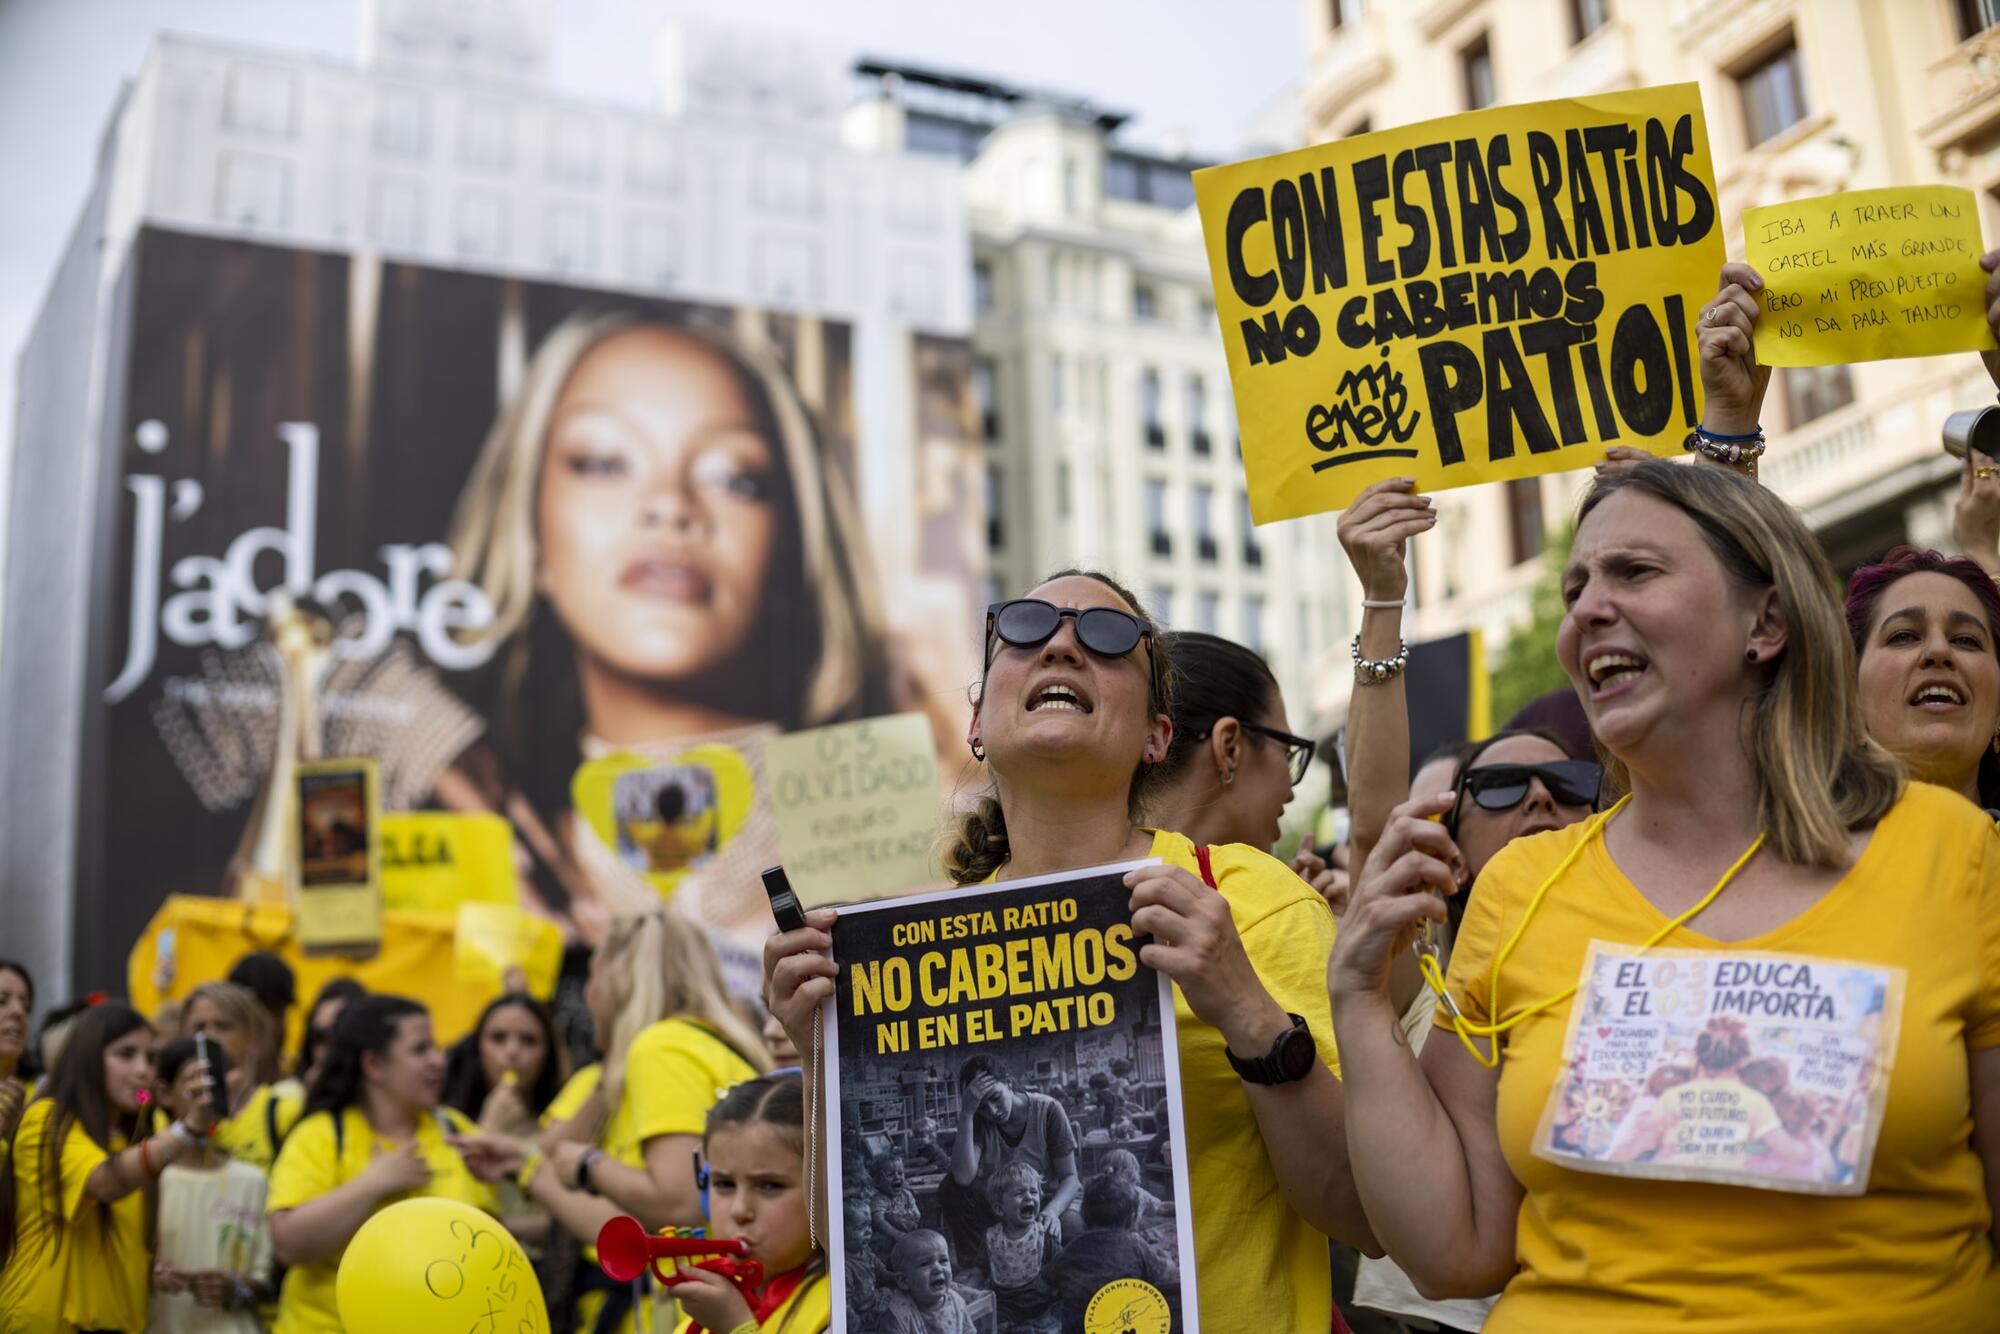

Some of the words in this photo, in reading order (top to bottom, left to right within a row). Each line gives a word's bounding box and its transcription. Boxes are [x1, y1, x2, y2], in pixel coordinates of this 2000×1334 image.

[1226, 167, 1348, 307] CON
[1352, 134, 1530, 285] ESTAS
[1761, 219, 1806, 244] IBA
[1829, 211, 1841, 229] A
[1853, 203, 1919, 225] TRAER
[1930, 203, 1961, 219] UN
[1768, 250, 1837, 273] CARTEL
[1760, 288, 1803, 313] PERO
[1849, 272, 1957, 301] PRESUPUESTO
[1240, 303, 1320, 366] NO
[1780, 322, 1803, 339] NO
[1814, 317, 1841, 333] DA
[1852, 308, 1891, 330] PARA
[1901, 304, 1961, 325] TANTO
[892, 919, 936, 947] CON
[940, 911, 998, 940] ESTA
[1003, 898, 1078, 931] RATIO
[851, 956, 913, 1017] NO
[919, 922, 1137, 1008] CABEMOS
[1615, 962, 1647, 988] EL
[1652, 960, 1708, 989] 0-3
[1714, 961, 1821, 992] EDUCA,
[876, 1018, 910, 1055] NI
[917, 1013, 959, 1050] EN
[966, 1008, 1003, 1043] EL
[1010, 991, 1115, 1039] PATIO
[1623, 991, 1652, 1017] EL
[1087, 1282, 1129, 1322] PLATAFORMA
[1133, 1282, 1165, 1310] LABORAL
